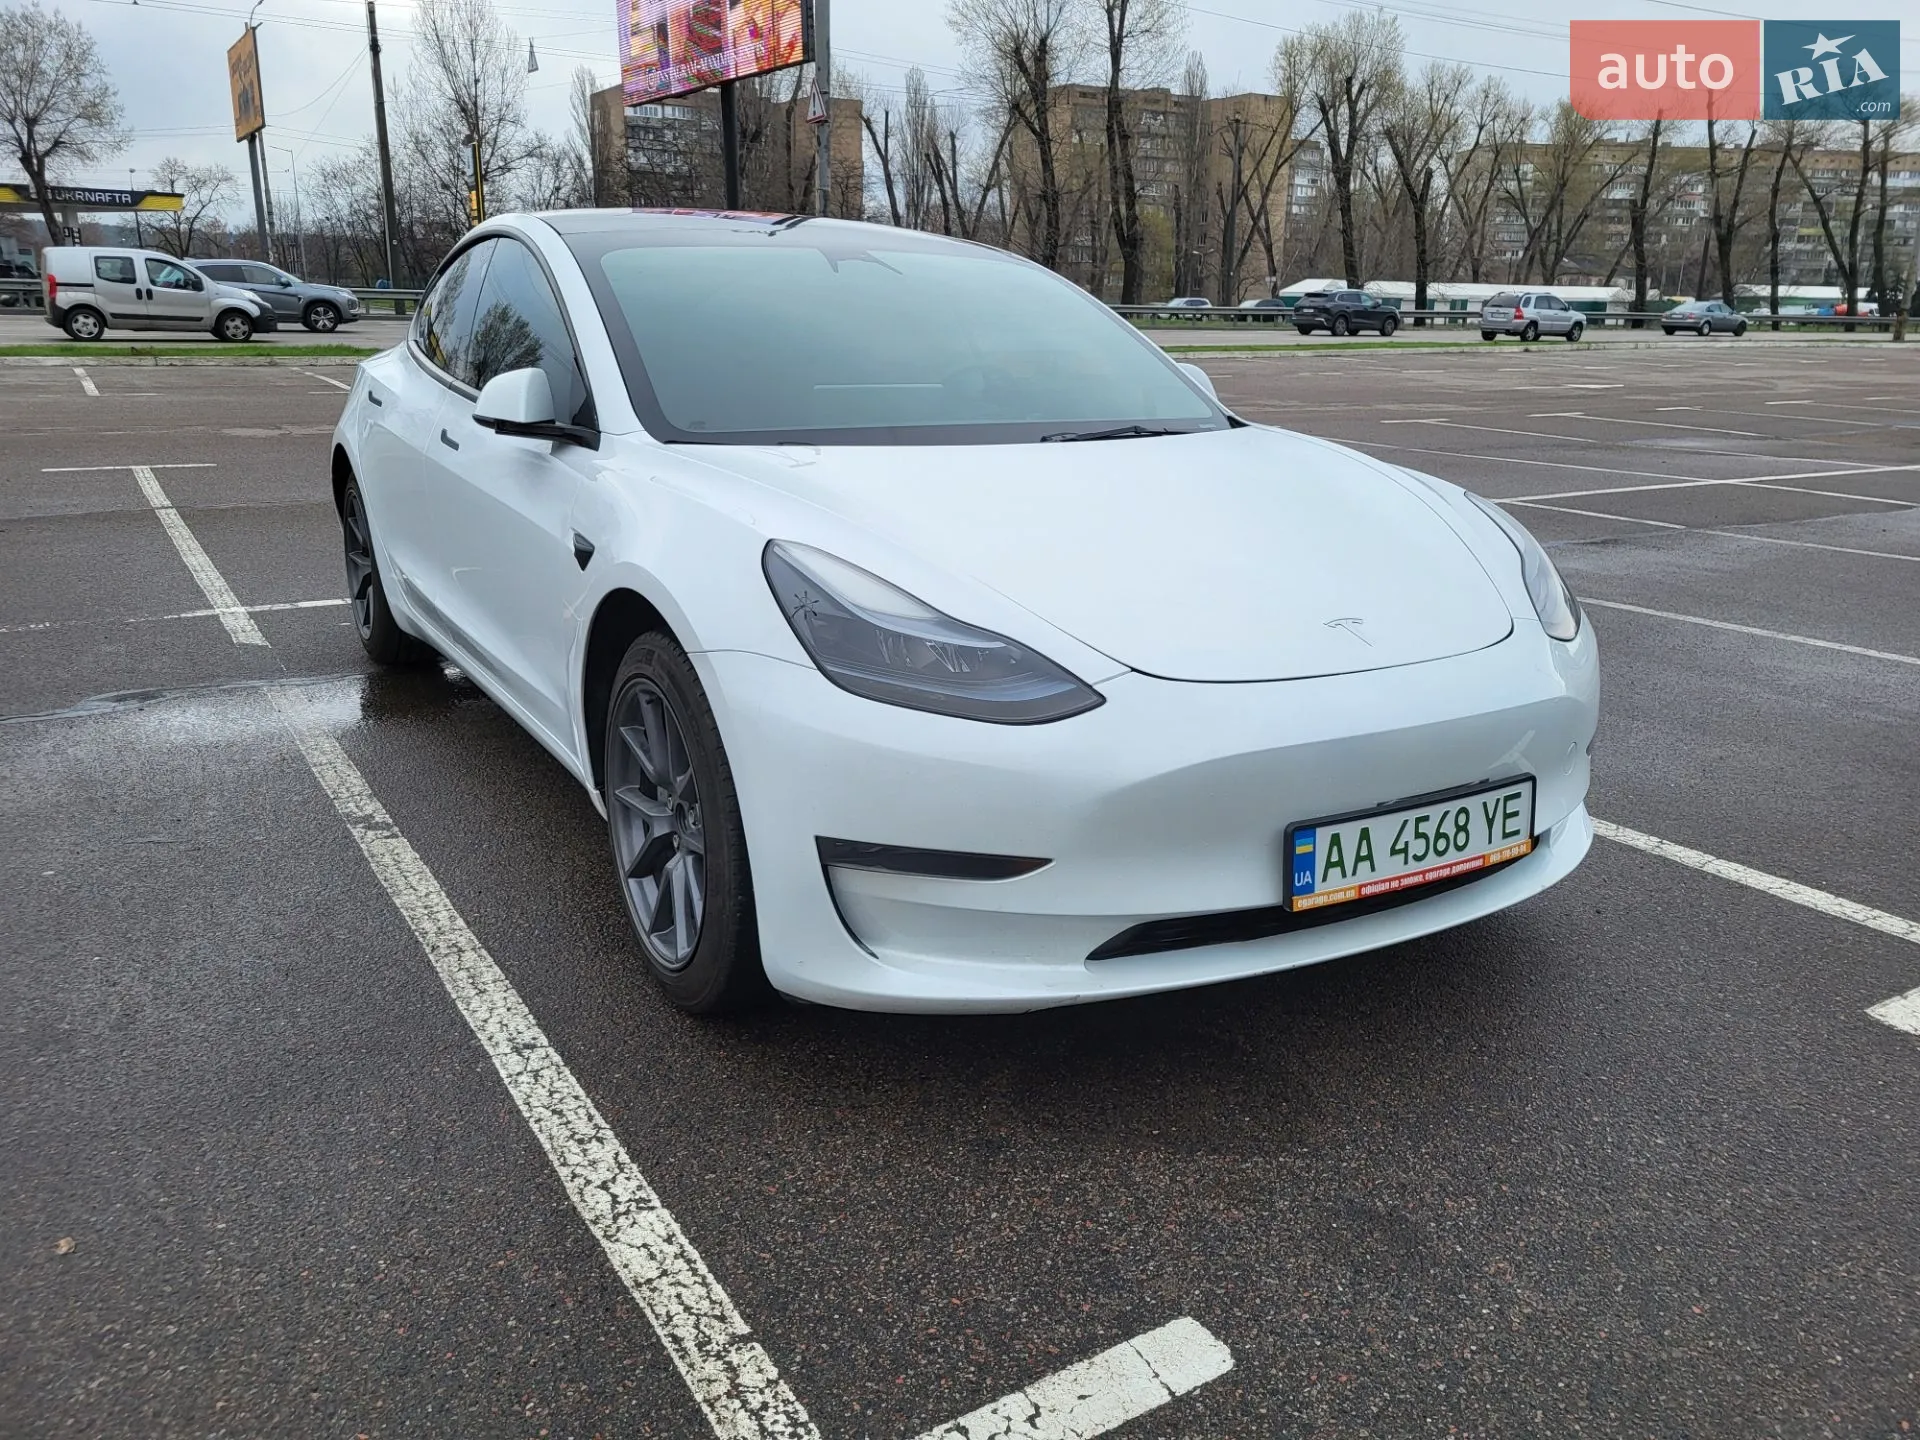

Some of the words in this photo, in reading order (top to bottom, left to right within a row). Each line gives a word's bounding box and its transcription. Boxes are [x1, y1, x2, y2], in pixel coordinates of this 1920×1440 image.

[1321, 826, 1376, 883] AA
[1389, 806, 1470, 866] 4568
[1482, 791, 1523, 845] YE
[1295, 872, 1312, 887] UA
